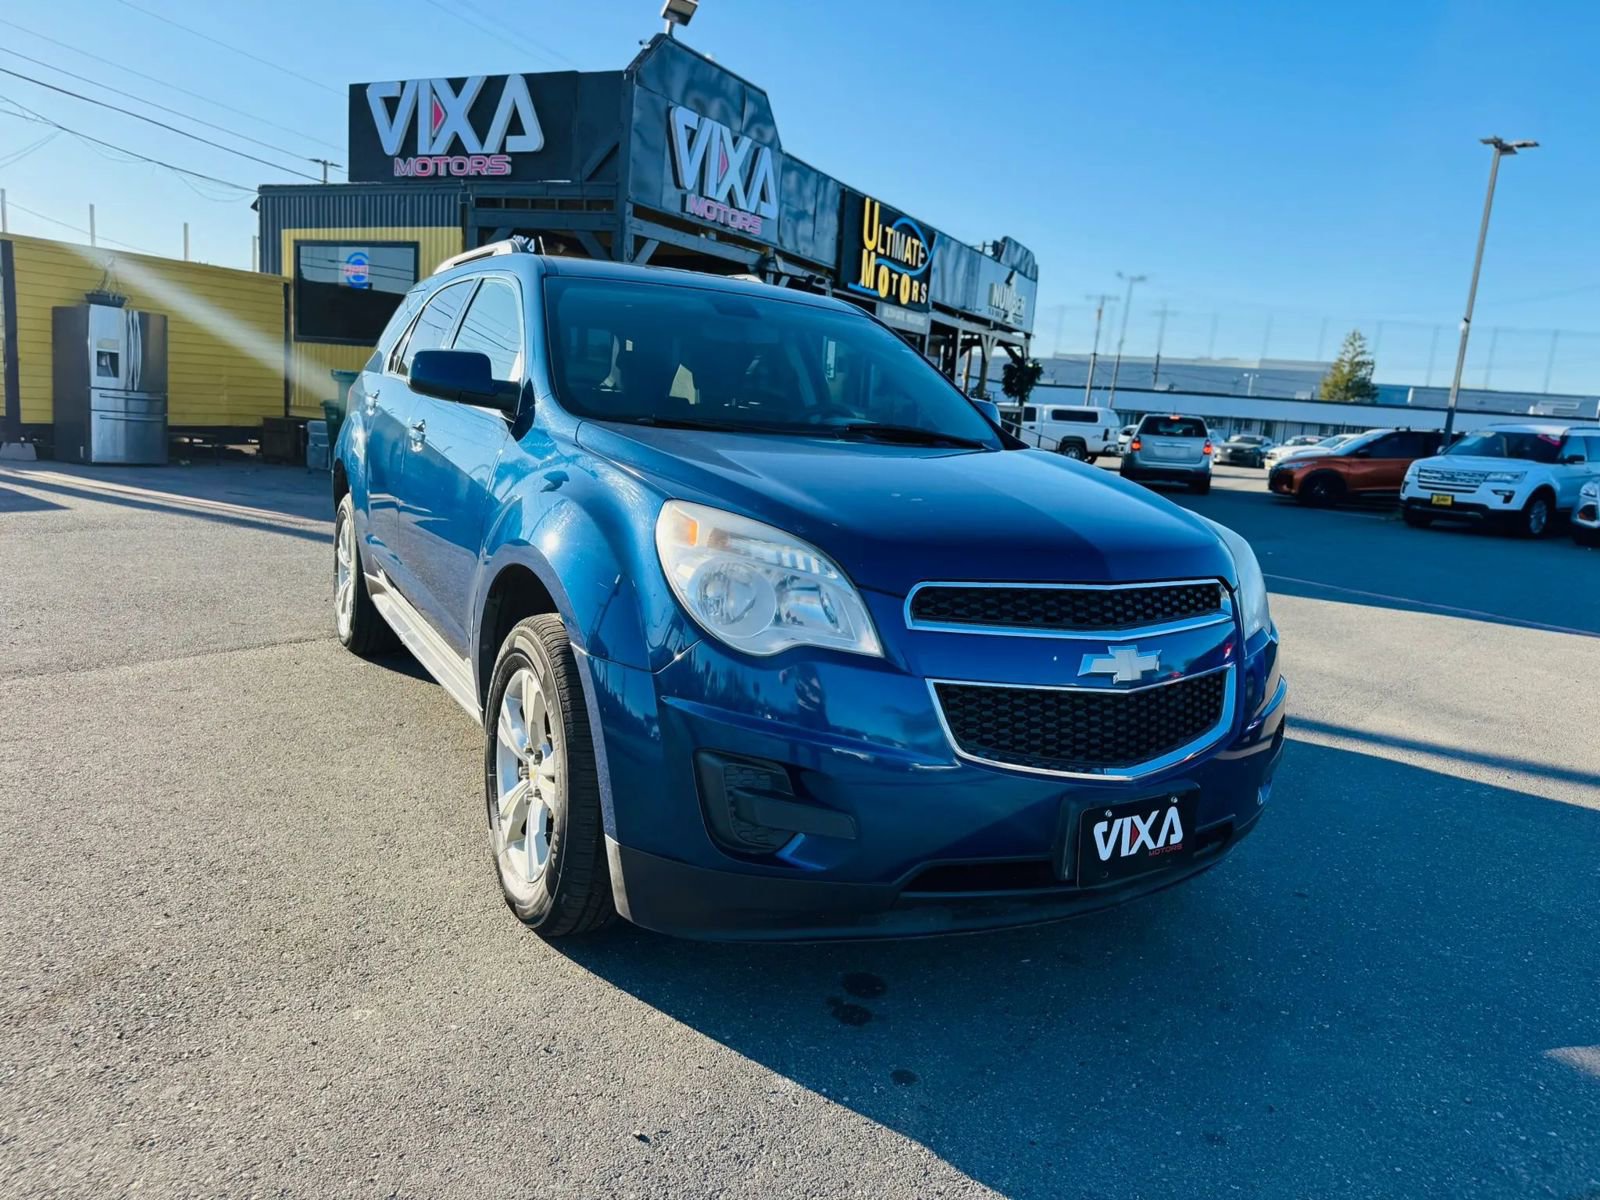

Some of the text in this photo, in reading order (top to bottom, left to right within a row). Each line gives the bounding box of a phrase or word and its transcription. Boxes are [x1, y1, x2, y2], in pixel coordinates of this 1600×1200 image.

[366, 74, 545, 156] VIXA
[393, 154, 512, 177] MOTORS
[670, 106, 779, 219] VIXA
[686, 194, 763, 235] MOTORS
[863, 197, 925, 268] ULTIMATE
[861, 249, 927, 305] MOTORS
[1093, 806, 1183, 861] VIXA
[1148, 844, 1183, 857] MOTORS
